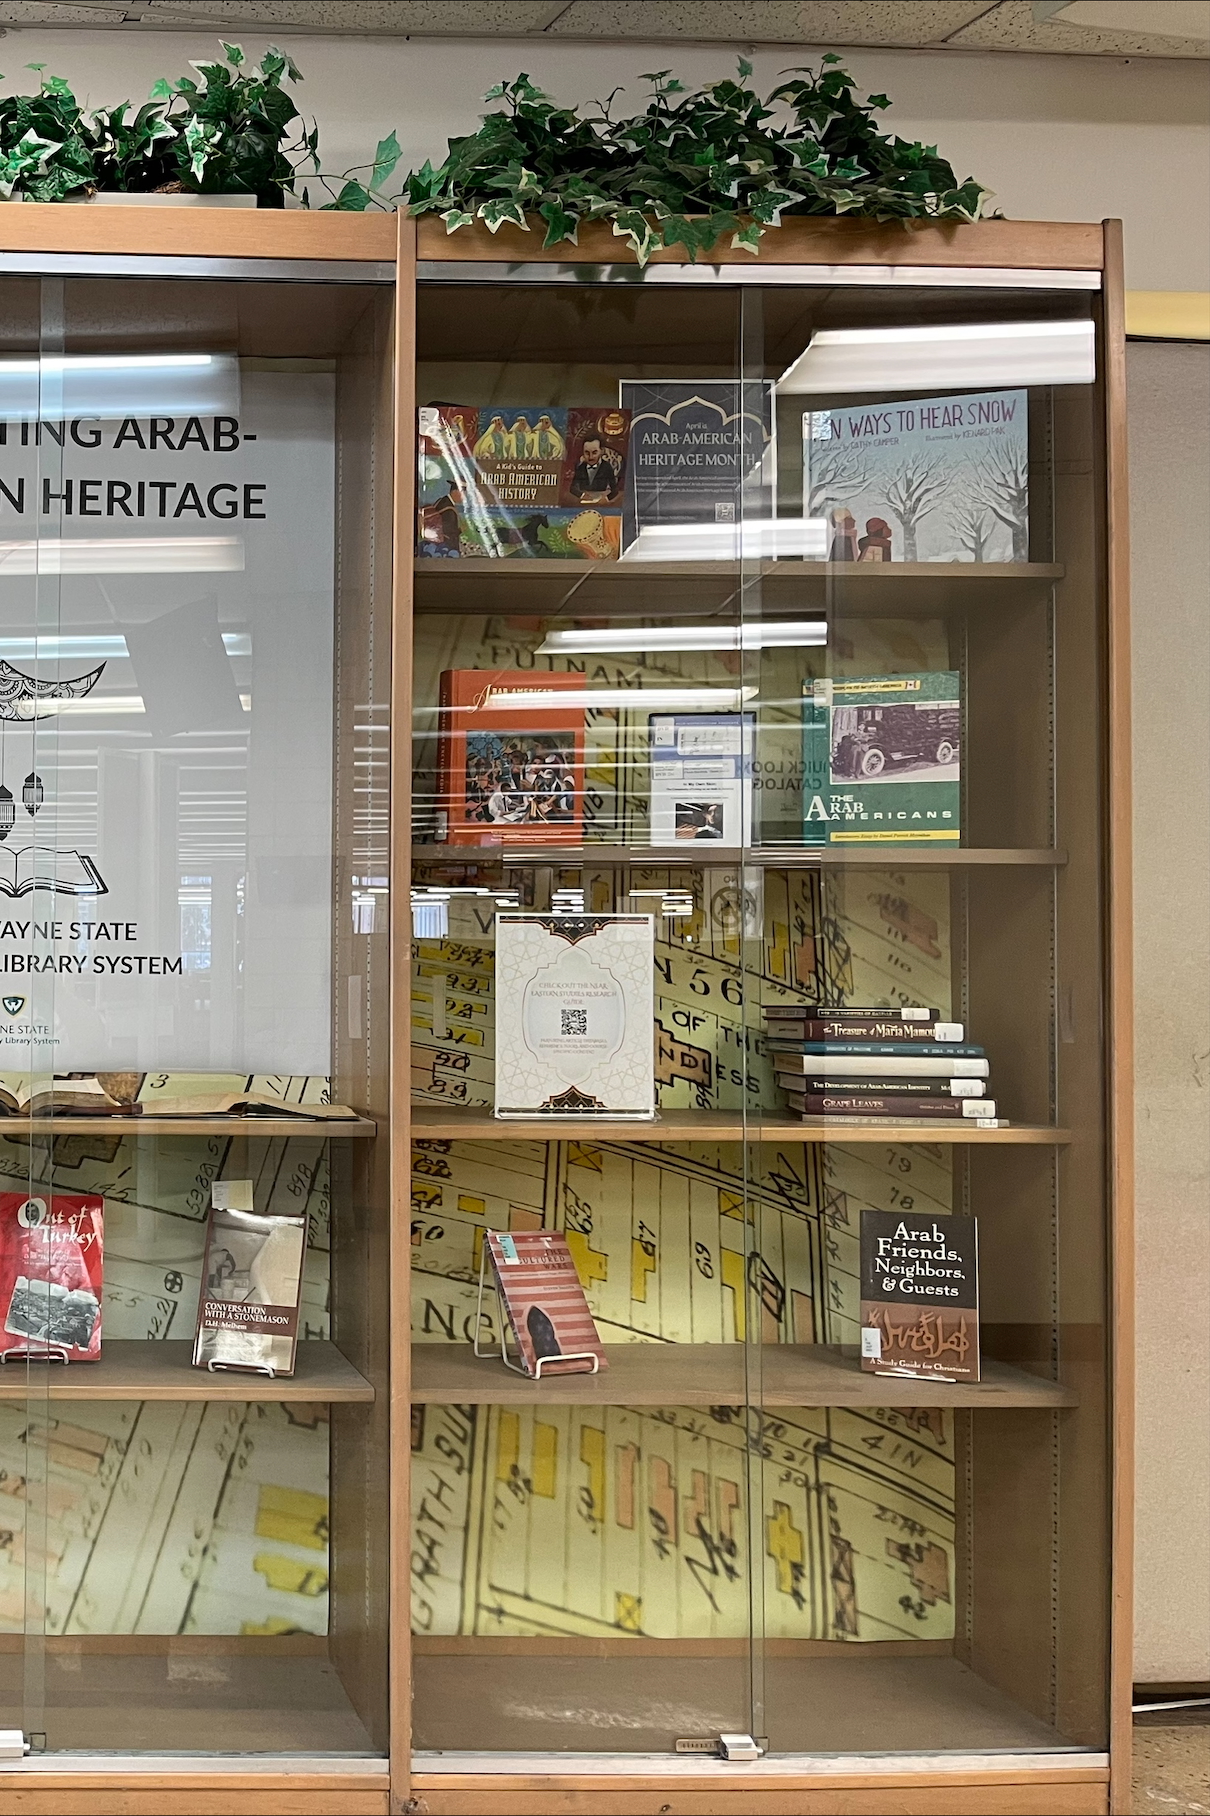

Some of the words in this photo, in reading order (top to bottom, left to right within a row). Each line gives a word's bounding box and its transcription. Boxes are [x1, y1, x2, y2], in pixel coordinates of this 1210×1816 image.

[685, 422, 701, 431] April
[849, 412, 893, 439] WAYS
[897, 410, 915, 432] TO
[920, 404, 964, 430] HEAR
[967, 398, 1017, 426] SNOW
[112, 415, 258, 452] ARAB-
[641, 432, 752, 445] ARAB-AMERICAN
[639, 453, 703, 466] HERITAGE
[705, 453, 755, 466] MONTH
[480, 472, 506, 485] ARAB
[508, 473, 557, 486] AMERICAN
[42, 477, 267, 520] HERITAGE
[498, 487, 538, 500] HISTORY
[804, 795, 864, 821] ARAB
[830, 810, 952, 821] AMERICANS
[69, 921, 138, 941] STATE
[92, 955, 183, 975] SYSTEM
[17, 1025, 50, 1034] STATE
[672, 1010, 706, 1033] OF
[830, 1023, 867, 1037] Treasure
[903, 1023, 936, 1039] Mamou
[5, 1036, 32, 1046] Library
[33, 1037, 60, 1046] System
[812, 1081, 824, 1089] THE
[822, 1098, 851, 1108] GRAPE
[852, 1099, 884, 1108] LEAVES
[67, 1204, 89, 1233] of
[39, 1223, 98, 1252] Turkey
[893, 1221, 946, 1243] Arab
[876, 1237, 964, 1263] Friends,
[543, 1262, 568, 1270] WARS
[874, 1257, 966, 1281] Neighbors,
[881, 1277, 897, 1292] &
[899, 1278, 960, 1297] Guests
[204, 1309, 226, 1319] WITH
[226, 1312, 234, 1320] A
[234, 1312, 290, 1325] STONEMASON
[205, 1302, 266, 1316] CONVERSATION
[869, 1357, 876, 1365] A
[898, 1359, 922, 1369] Guide
[922, 1361, 933, 1370] for
[933, 1363, 971, 1373] Christians
